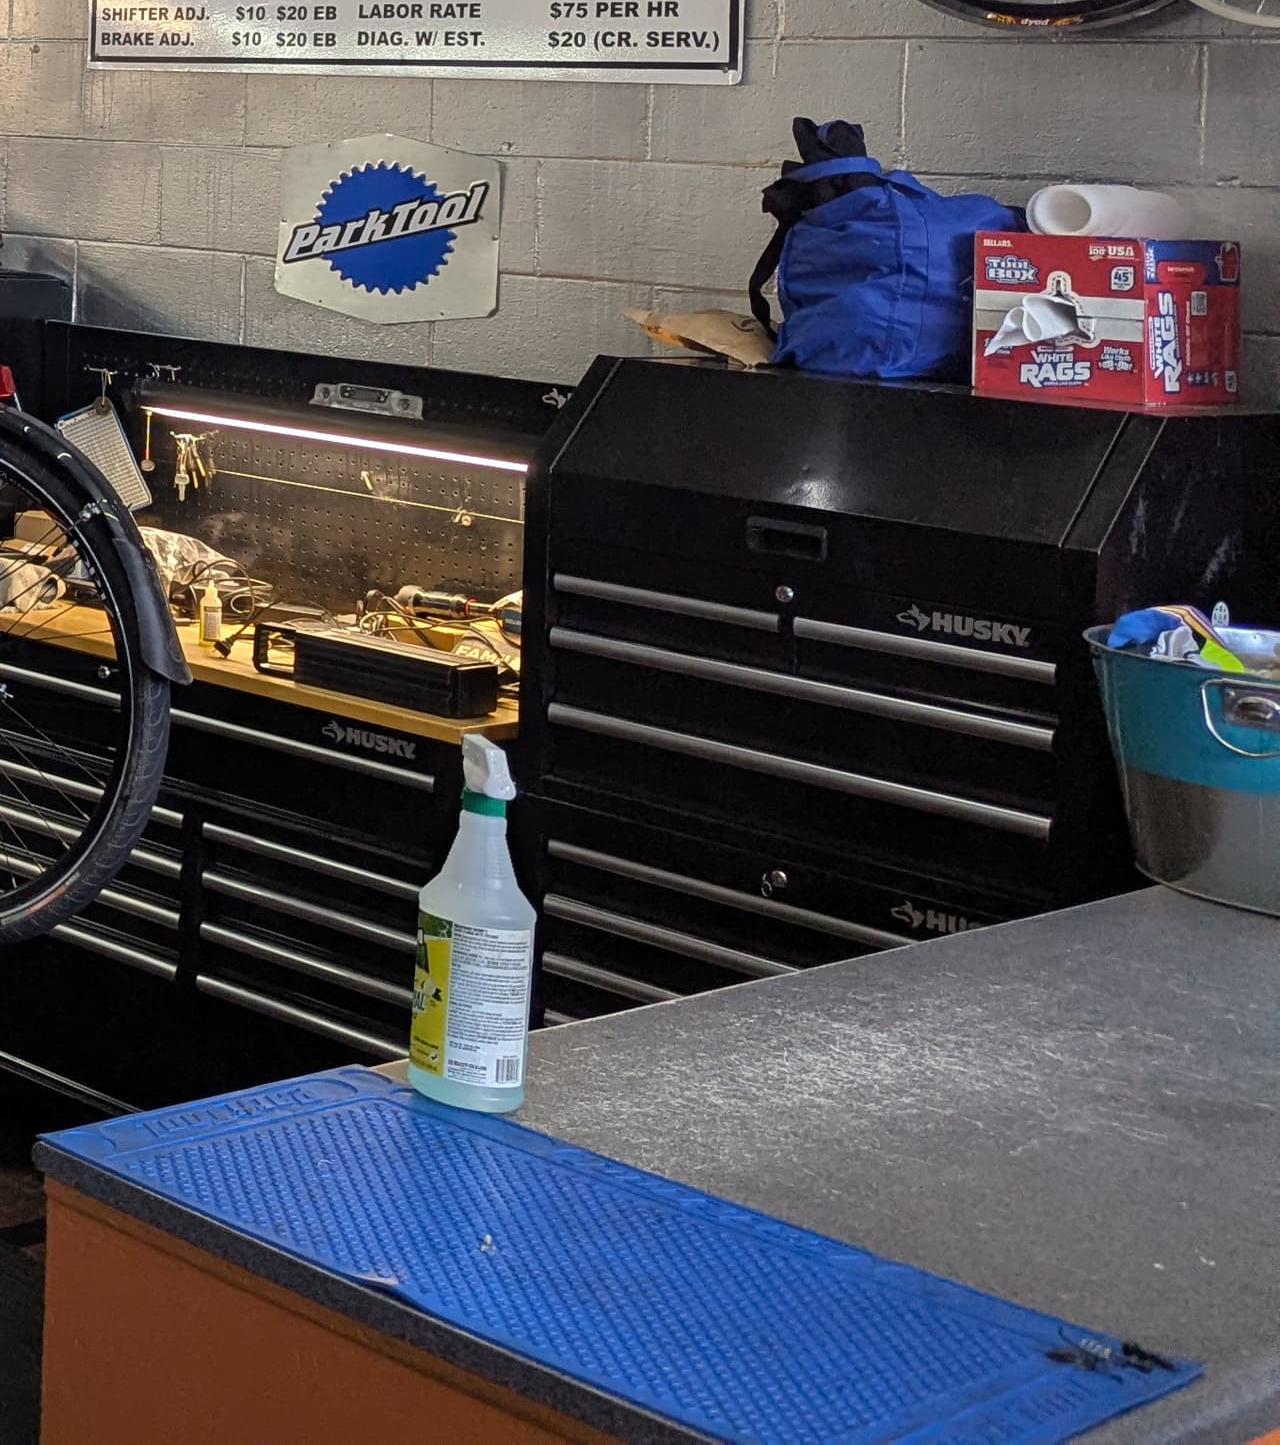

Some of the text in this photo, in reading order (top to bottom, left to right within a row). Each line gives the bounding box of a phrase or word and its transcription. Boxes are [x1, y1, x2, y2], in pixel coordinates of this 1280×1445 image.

[102, 6, 336, 21] SHIFTER ADJ. $10 $20 EB
[359, 1, 678, 19] LABOR RATE $75 PER HR
[102, 32, 336, 47] BRAKE ADJ. $10 $20 EB
[358, 31, 719, 52] DIAG. W/ EST. $20 (CR. SERV.)
[988, 268, 1038, 283] BOX
[1153, 317, 1164, 379] WHITE
[1158, 292, 1182, 392] RAGS
[1031, 350, 1074, 362] WHITE
[1020, 361, 1091, 388] RAGS
[930, 611, 1031, 647] HUSKY
[345, 726, 417, 760] HUSKY
